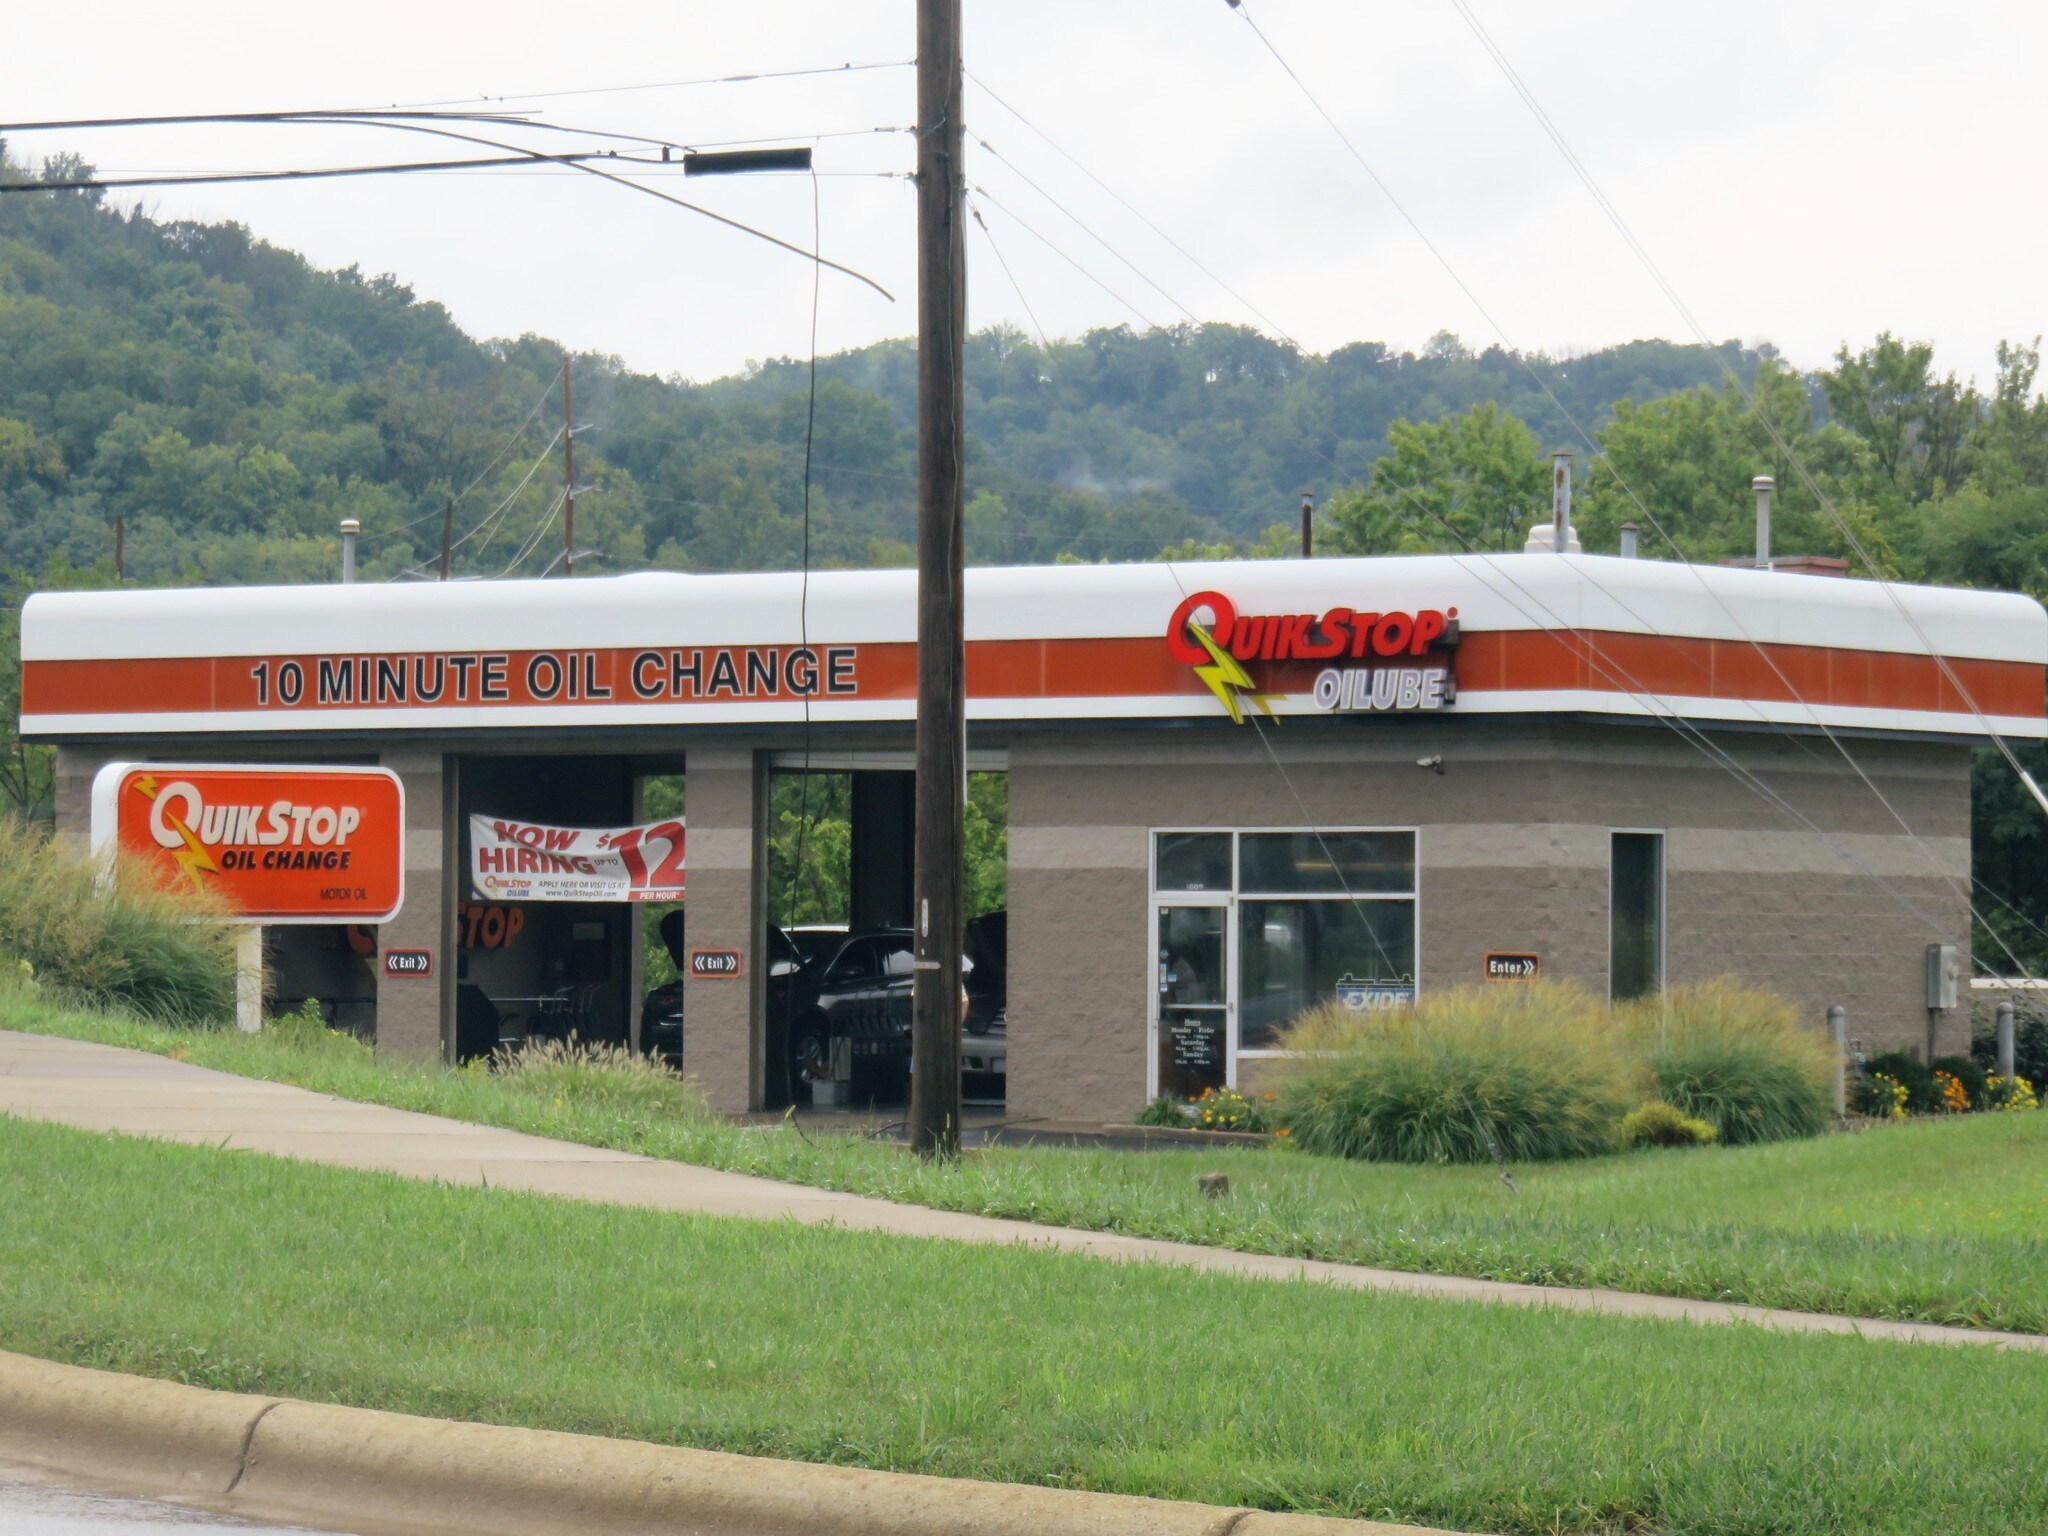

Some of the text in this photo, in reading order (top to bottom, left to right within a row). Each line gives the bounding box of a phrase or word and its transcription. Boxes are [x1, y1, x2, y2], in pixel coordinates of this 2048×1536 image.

[250, 647, 859, 706] 10 MINUTE OIL CHANGE
[1313, 668, 1446, 711] OILUBE
[493, 820, 581, 851] NOW
[221, 850, 352, 872] OIL CHANGE
[479, 847, 598, 875] HIRING
[594, 858, 619, 866] UP TO
[320, 888, 368, 901] MOTOR OIL
[457, 904, 525, 949] TOP
[400, 957, 415, 968] Exit
[707, 957, 723, 969] Exit
[1490, 960, 1521, 973] Enter
